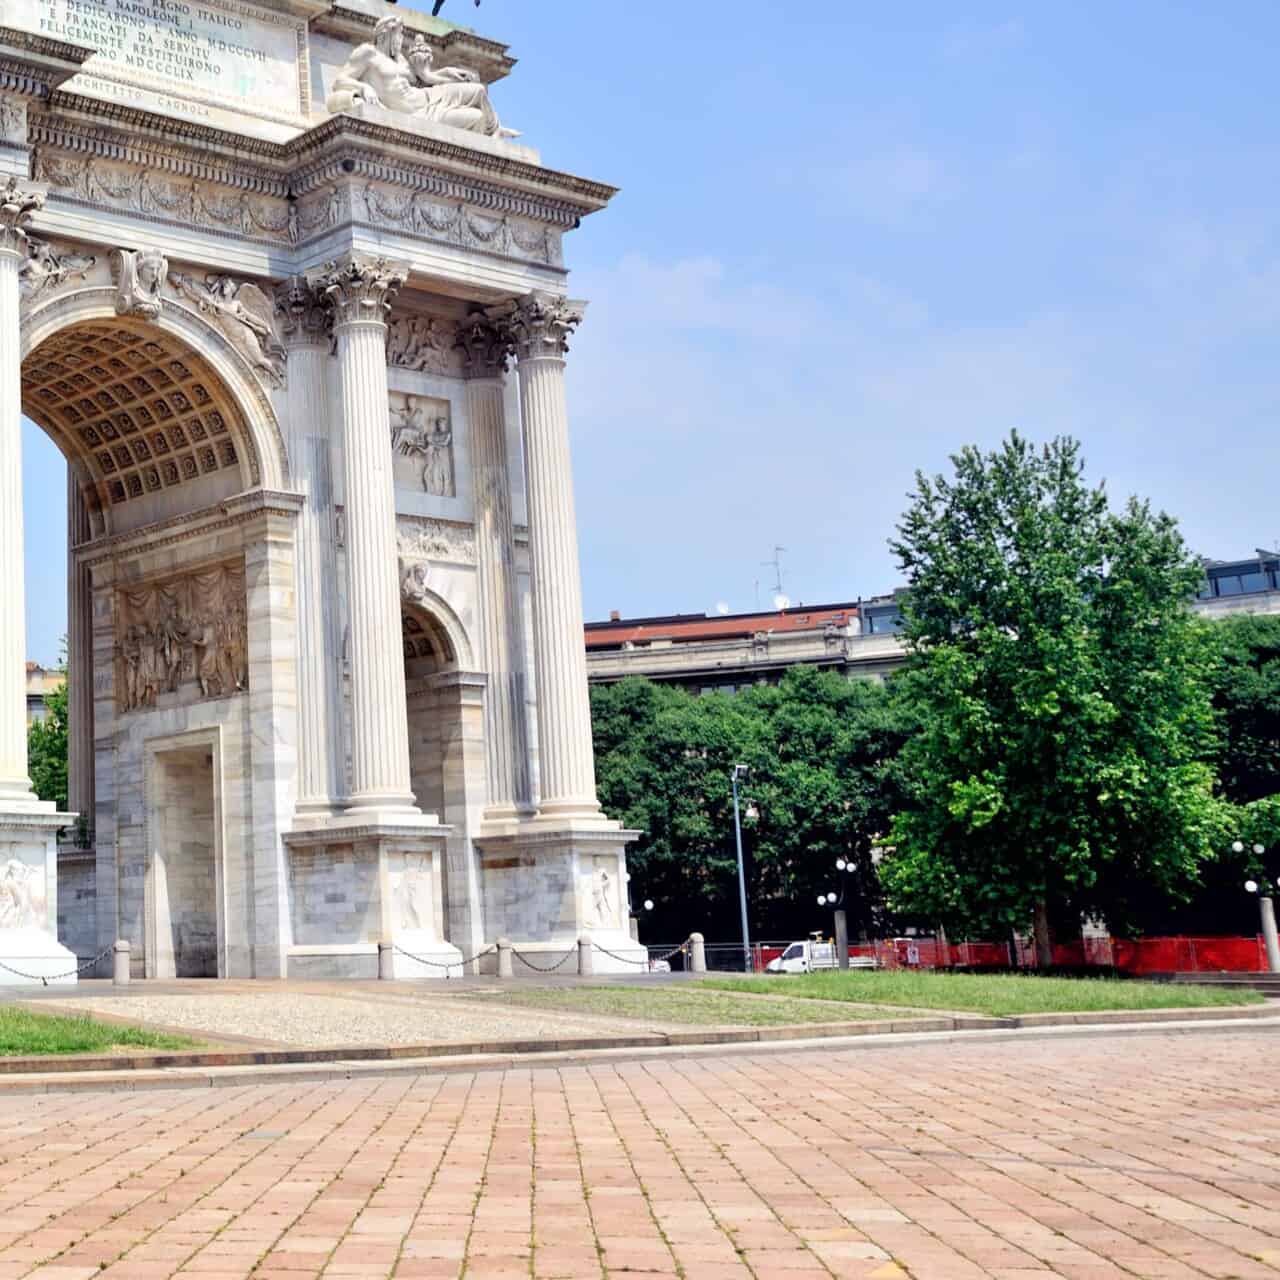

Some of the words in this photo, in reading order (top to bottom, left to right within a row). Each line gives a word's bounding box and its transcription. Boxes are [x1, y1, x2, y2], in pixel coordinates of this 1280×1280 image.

[50, 8, 56, 19] E
[66, 12, 126, 38] FRANCATI
[138, 32, 152, 44] DA
[116, 0, 180, 26] NAPOLEONE
[198, 10, 242, 30] ITALICO
[40, 18, 123, 49] FELICEMENTE
[133, 43, 221, 75] RESTITUIRONO
[67, 0, 146, 29] DEDICARONO
[208, 38, 266, 62] MDCCCVII
[96, 47, 117, 60] NO
[126, 54, 194, 80] MDCCCLIX
